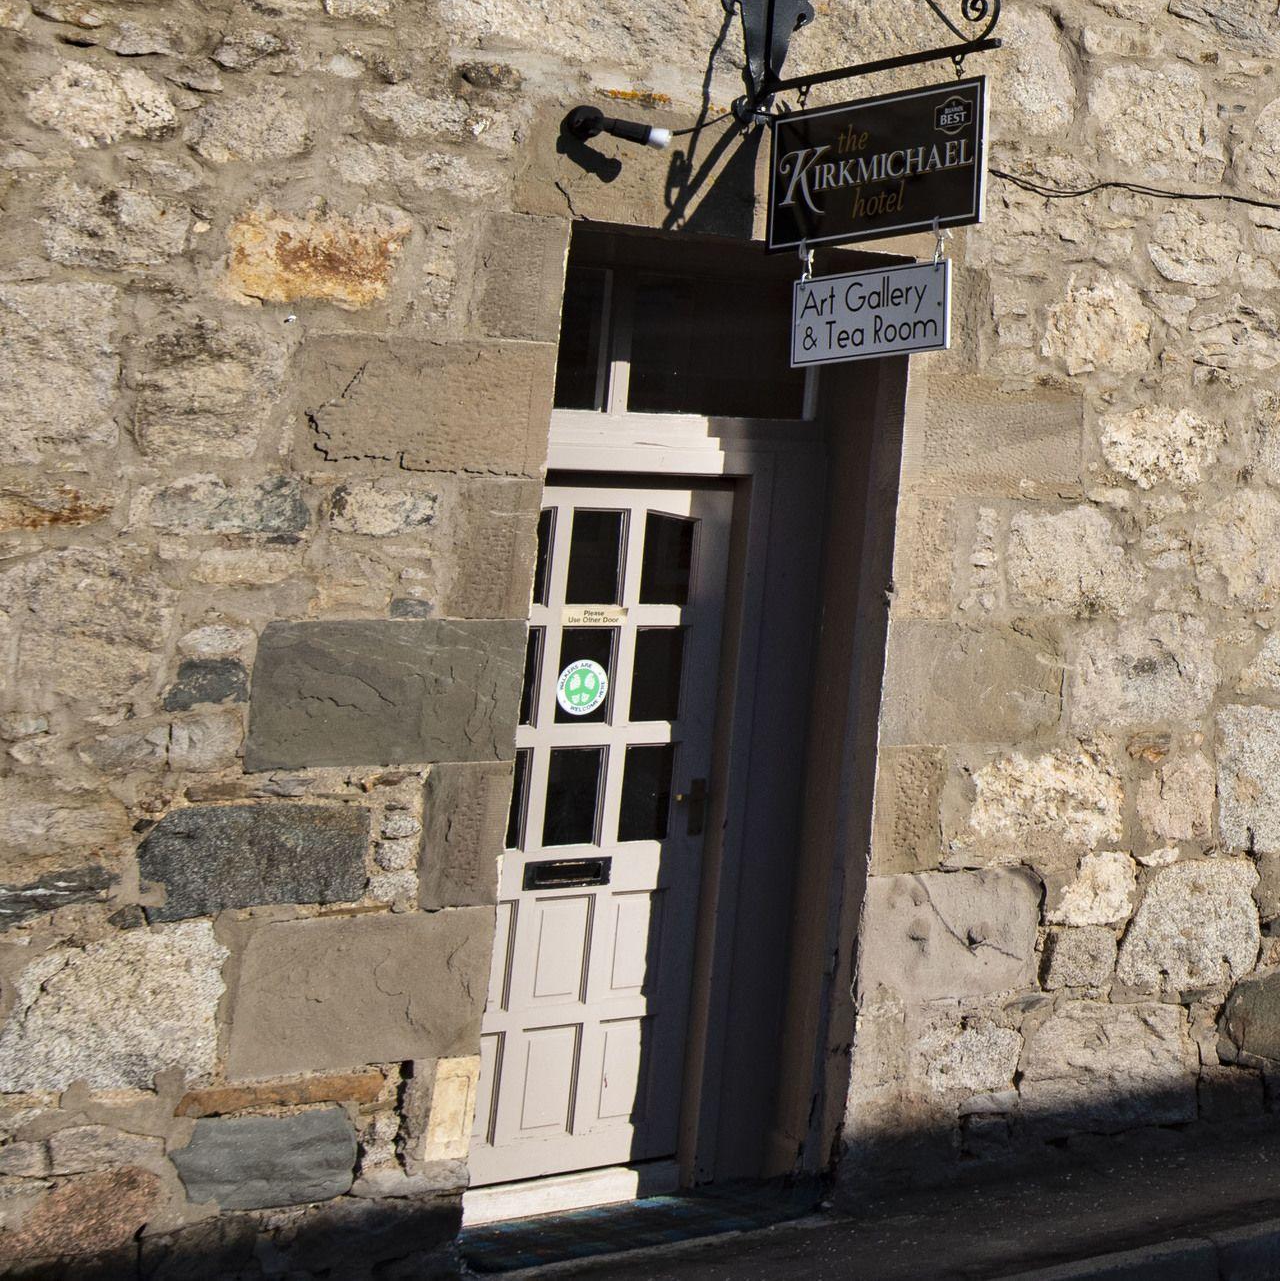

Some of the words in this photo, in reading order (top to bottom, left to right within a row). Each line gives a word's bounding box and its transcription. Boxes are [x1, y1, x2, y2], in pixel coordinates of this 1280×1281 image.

[940, 111, 967, 126] BEST
[838, 124, 869, 155] the
[778, 138, 975, 215] KIRKMICHAEL
[852, 180, 906, 219] hotel
[800, 285, 836, 318] Art
[845, 275, 928, 314] Gallery
[802, 325, 818, 351] &
[825, 320, 865, 350] Tea
[873, 315, 938, 345] Room
[560, 664, 579, 691] WALKERS
[569, 700, 599, 713] WELCOME
